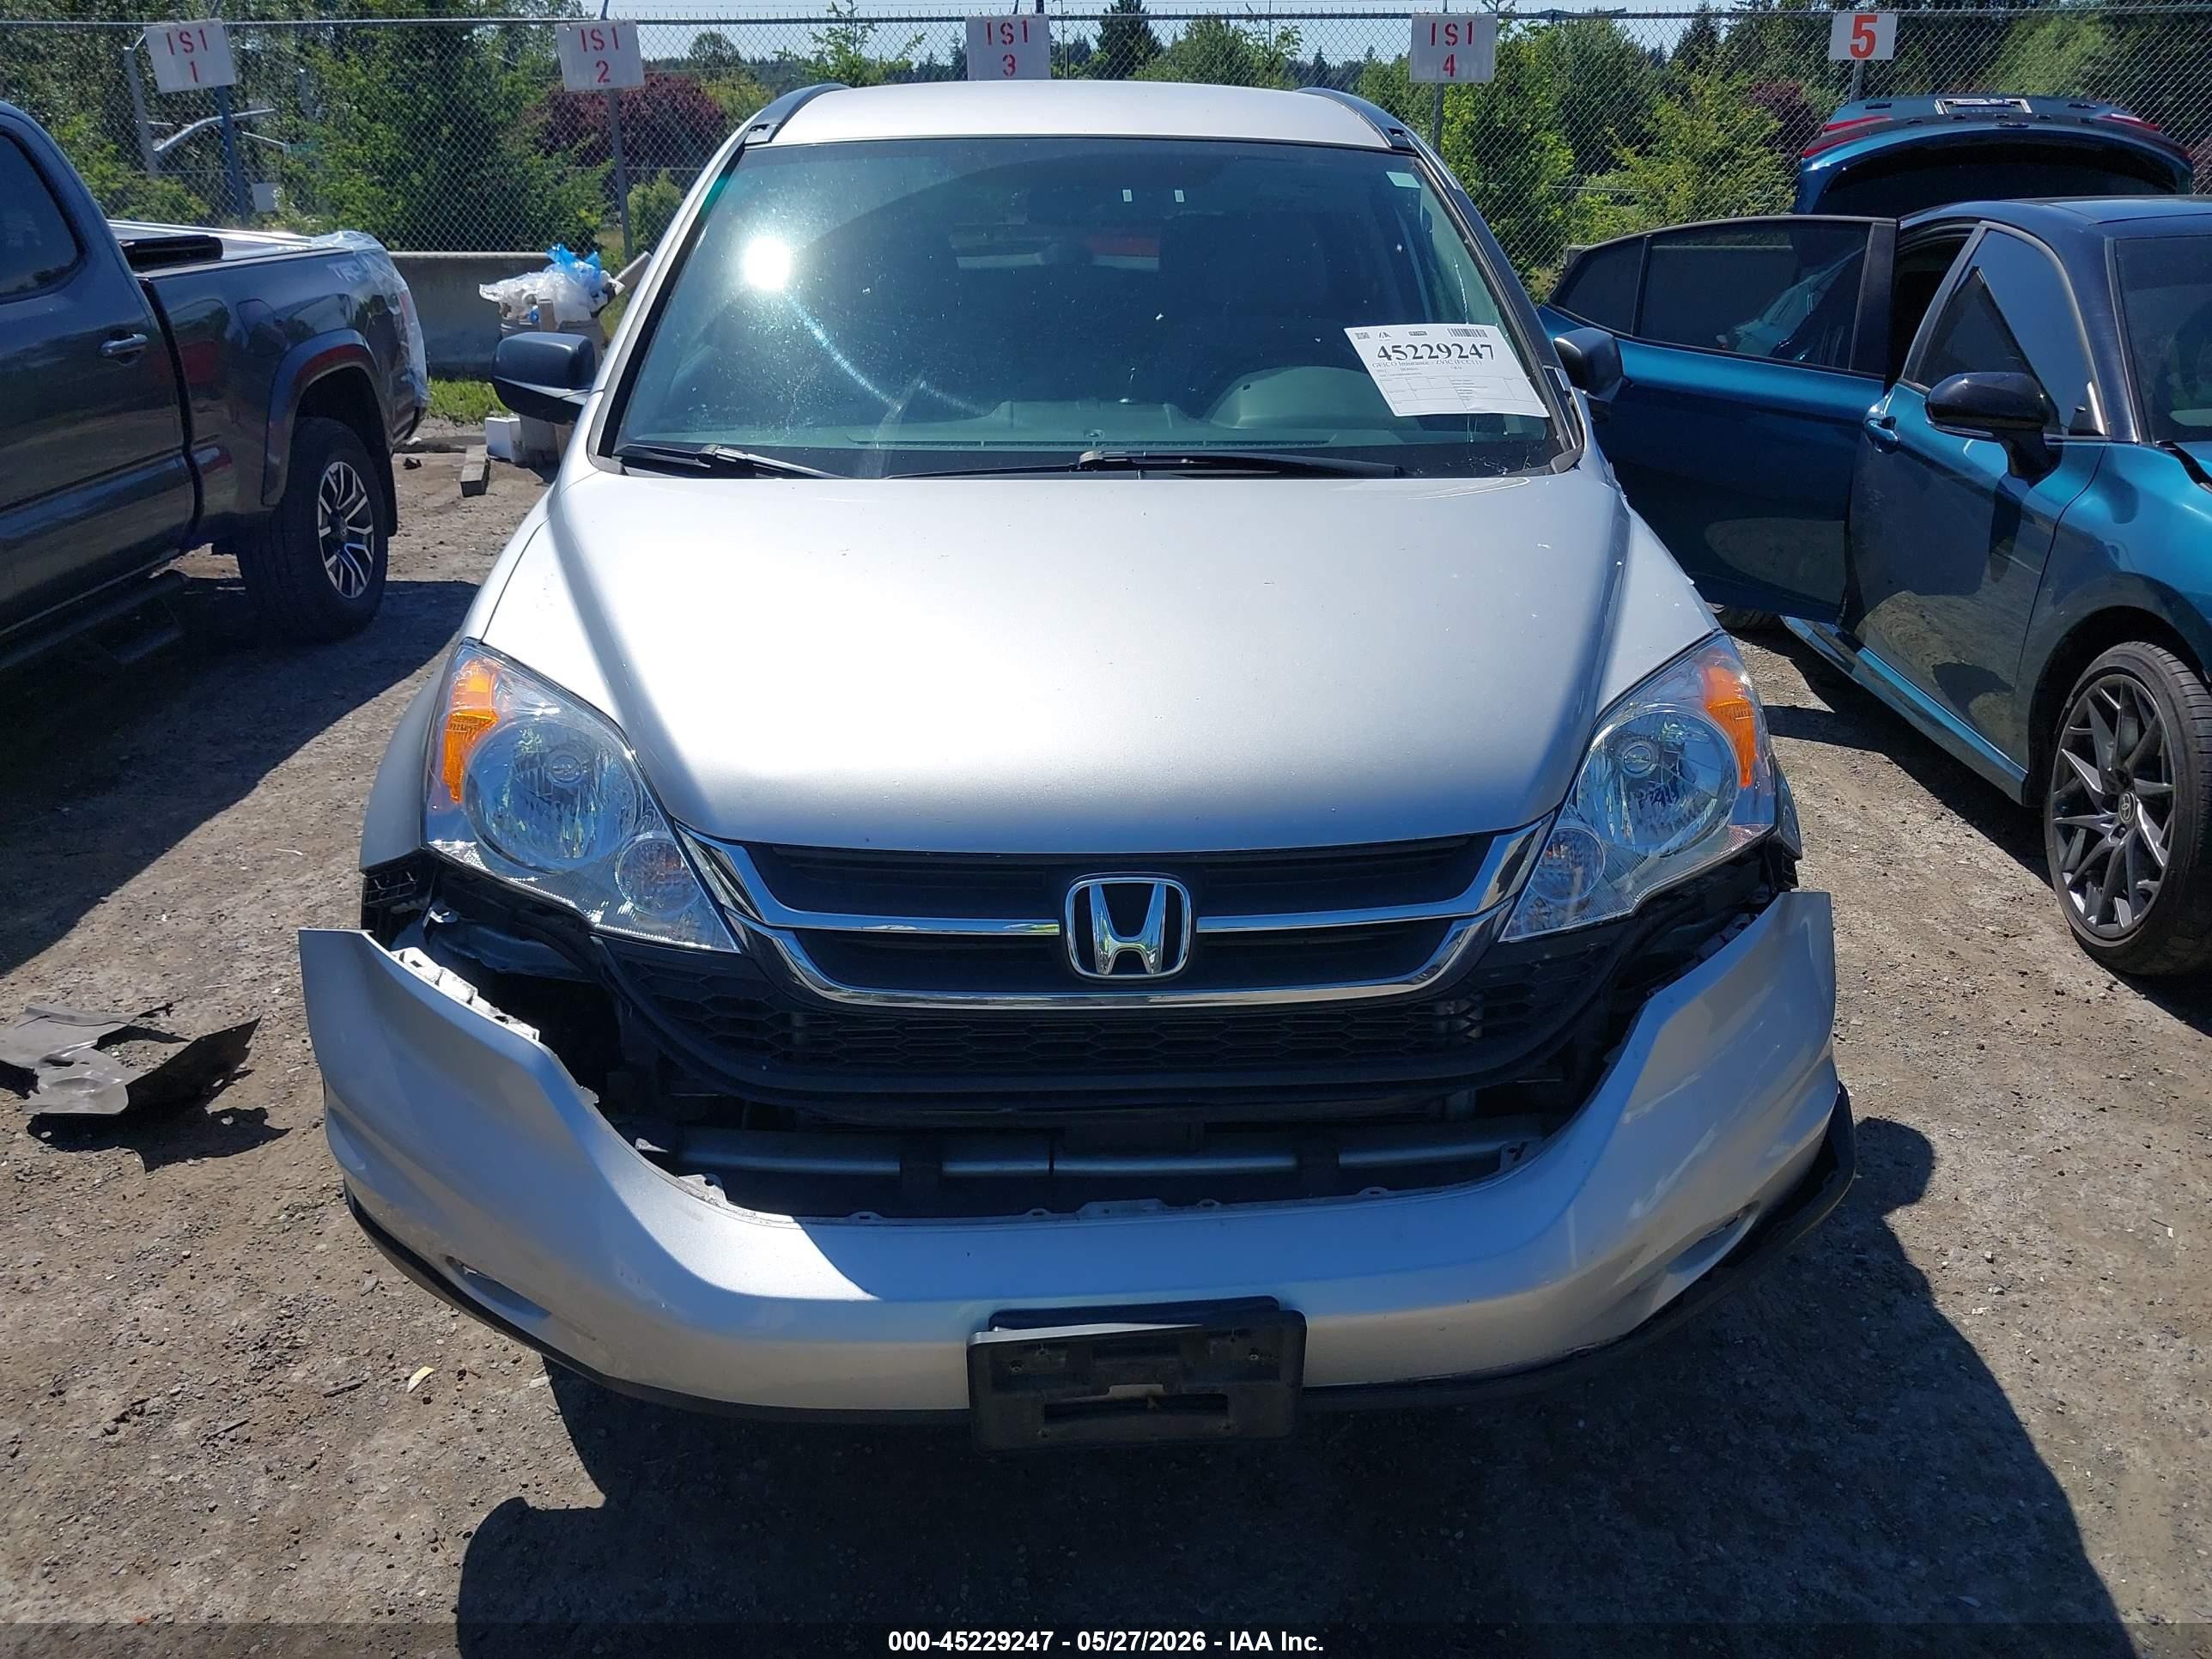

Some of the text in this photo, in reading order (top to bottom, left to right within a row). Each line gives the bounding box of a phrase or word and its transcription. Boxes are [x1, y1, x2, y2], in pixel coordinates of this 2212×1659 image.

[1850, 14, 1878, 58] 5
[596, 60, 611, 83] 2
[1002, 54, 1017, 76] 3
[1443, 54, 1455, 77] 4
[1376, 343, 1494, 361] 45229247
